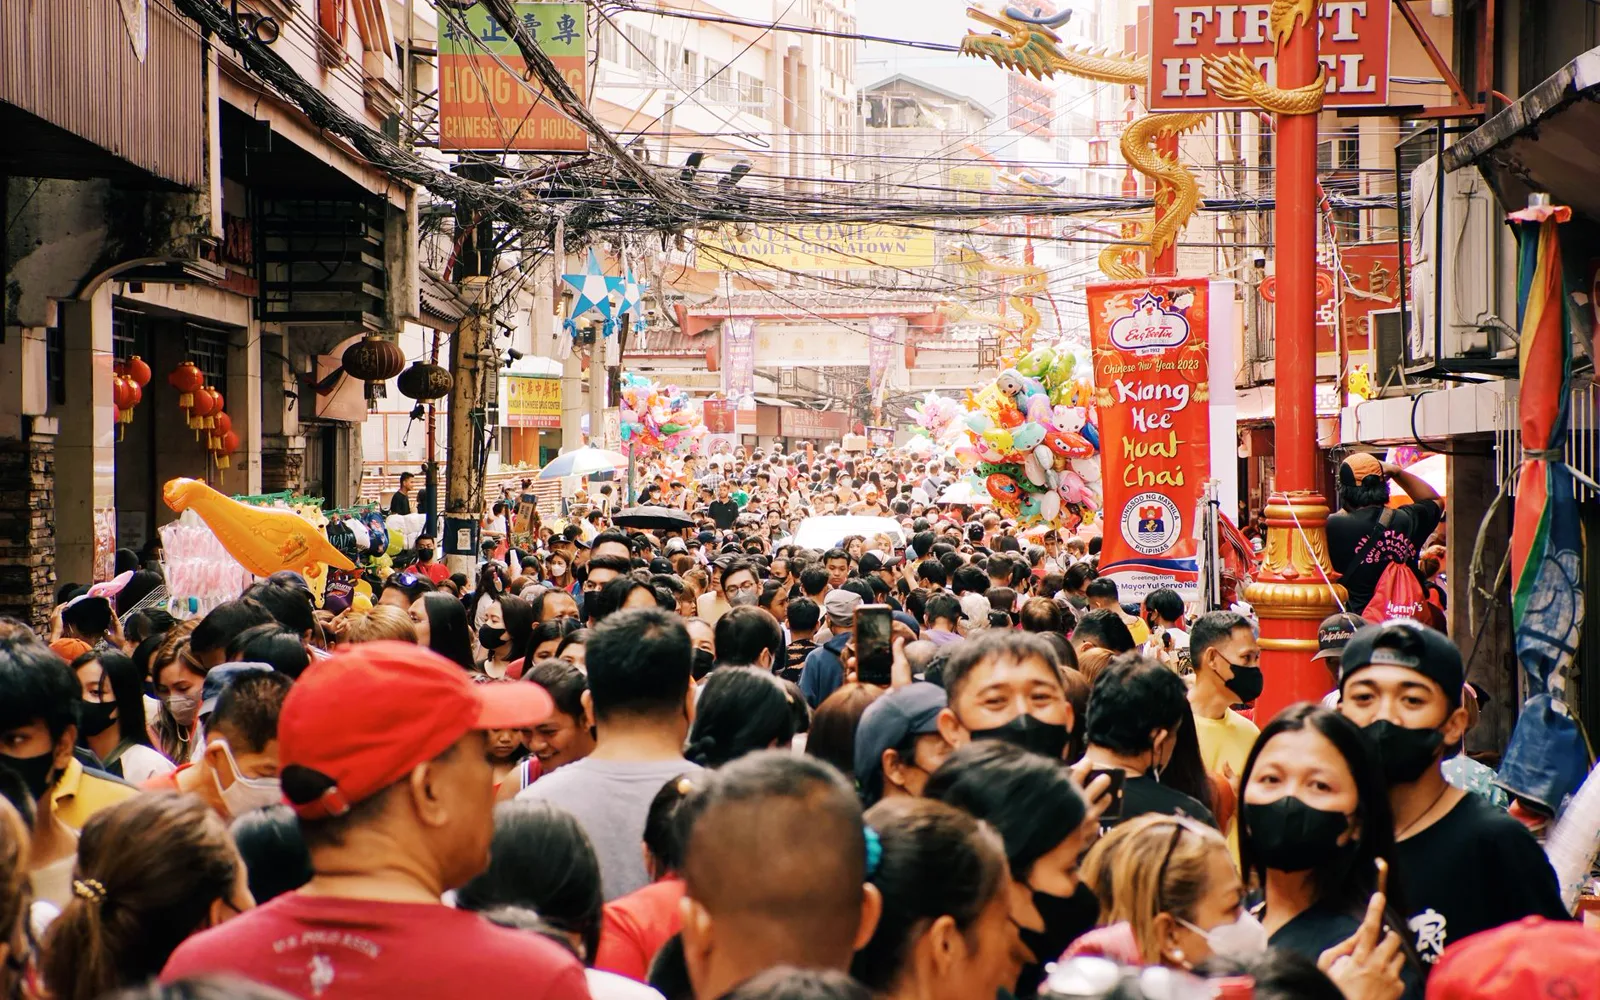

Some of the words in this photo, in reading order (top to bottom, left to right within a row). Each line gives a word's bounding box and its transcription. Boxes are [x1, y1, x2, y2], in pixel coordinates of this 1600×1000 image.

[1173, 1, 1367, 46] FIRT
[444, 65, 512, 105] HONG
[517, 67, 583, 106] KG
[444, 116, 497, 139] CHINESE
[501, 117, 535, 140] DRUG
[540, 118, 582, 140] HOUSE
[801, 241, 907, 255] CHINATOWN
[1104, 363, 1136, 375] Chinese
[1138, 361, 1152, 372] New
[1154, 360, 1176, 373] Year
[1177, 359, 1199, 371] 2023
[1131, 406, 1174, 433] Hee
[1121, 430, 1187, 462] Huat
[1123, 463, 1185, 488] Chai
[1122, 494, 1145, 523] LUNGSOD
[1157, 494, 1180, 521] MAYNILA
[1134, 543, 1169, 554] PILIPINAS
[1121, 582, 1145, 591] Mayor
[1387, 600, 1423, 615] Henry's
